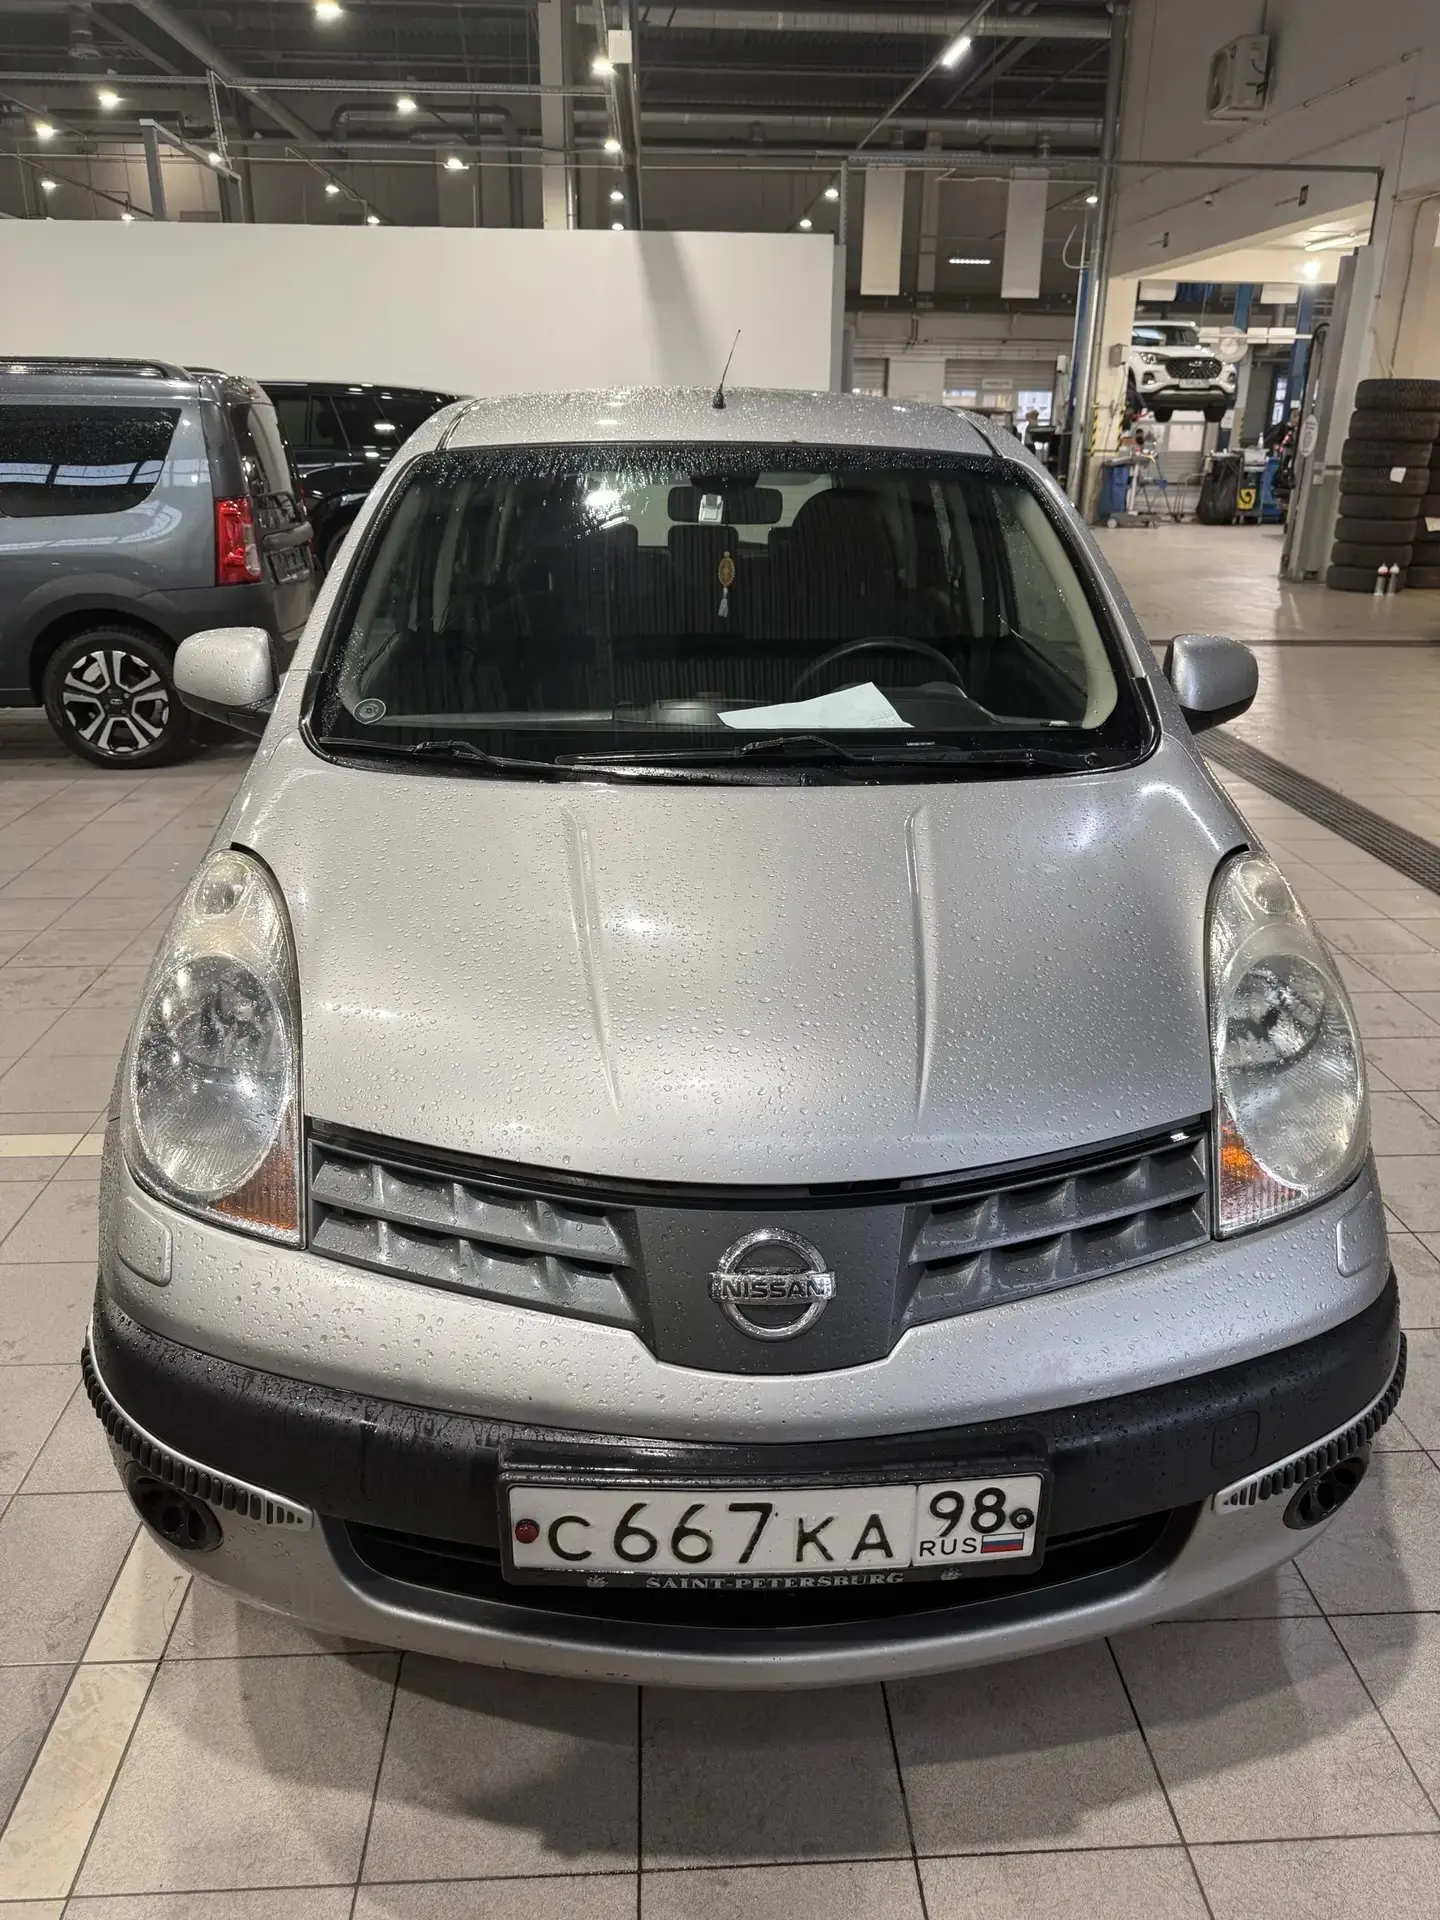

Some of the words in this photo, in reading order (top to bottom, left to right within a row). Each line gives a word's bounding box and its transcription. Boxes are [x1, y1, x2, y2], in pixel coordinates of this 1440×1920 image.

[721, 1278, 826, 1299] NISSAN
[929, 1487, 1007, 1537] 98
[919, 1537, 978, 1558] RUS
[645, 1572, 905, 1590] SAINT-PETERSBURG
